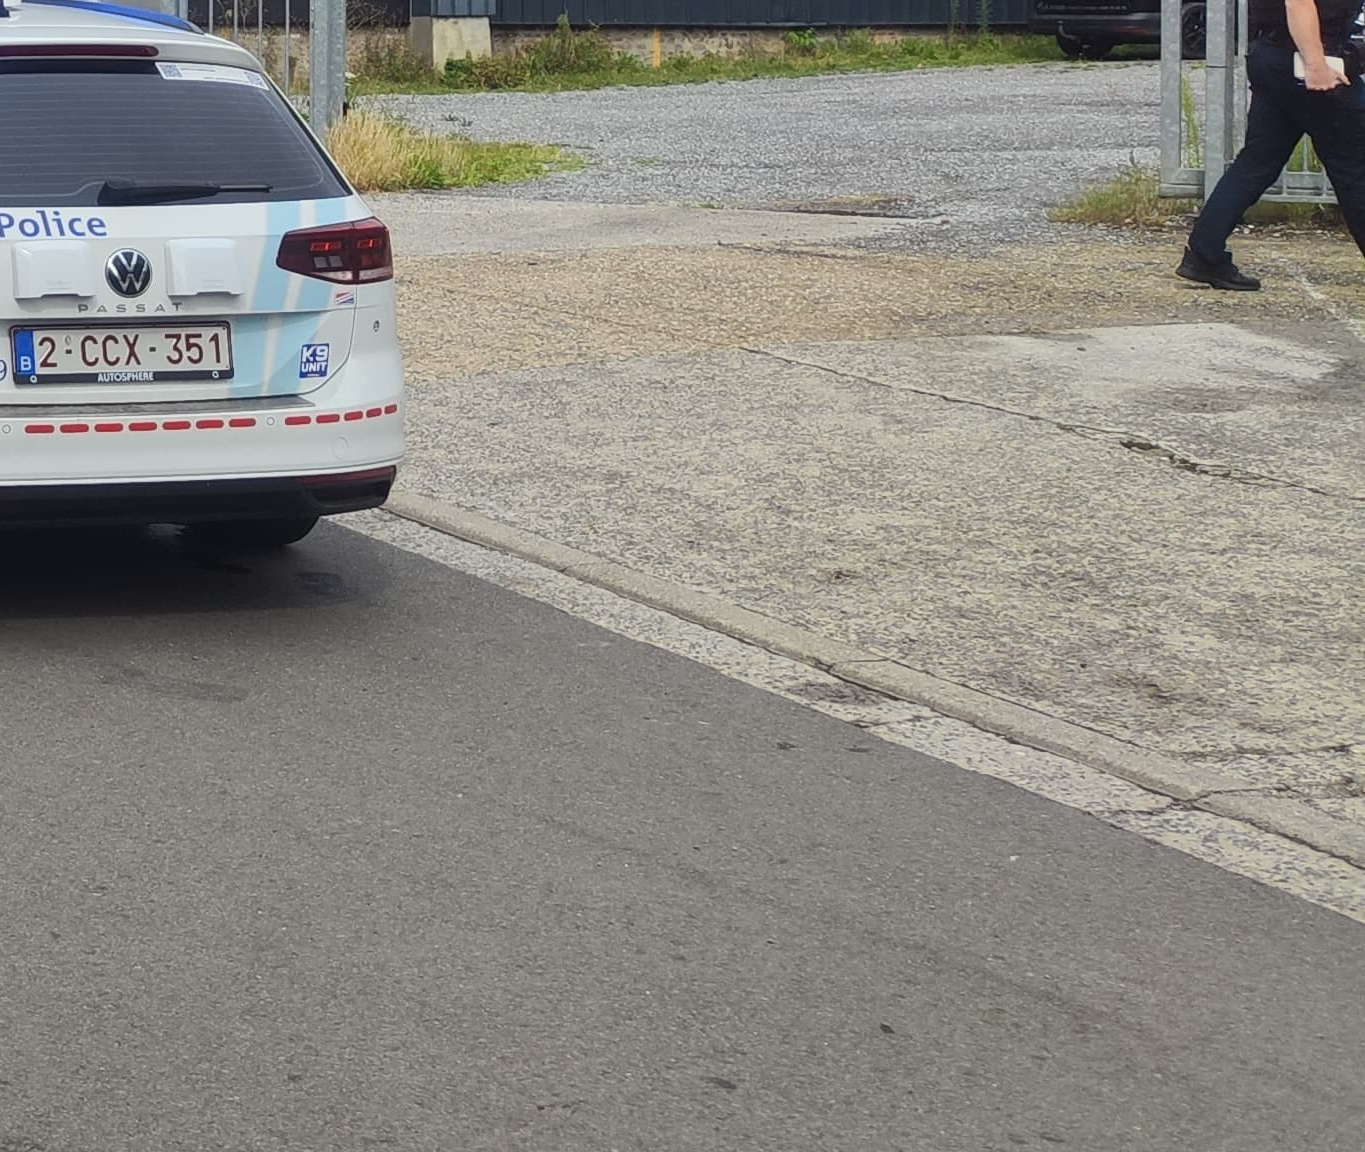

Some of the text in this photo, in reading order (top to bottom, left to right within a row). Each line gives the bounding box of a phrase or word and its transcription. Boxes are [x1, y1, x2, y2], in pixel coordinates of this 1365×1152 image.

[77, 302, 183, 313] PASSAT
[302, 345, 329, 362] K9
[20, 356, 32, 371] B
[301, 361, 327, 373] UNIT
[97, 372, 154, 382] AUTOSPHERE
